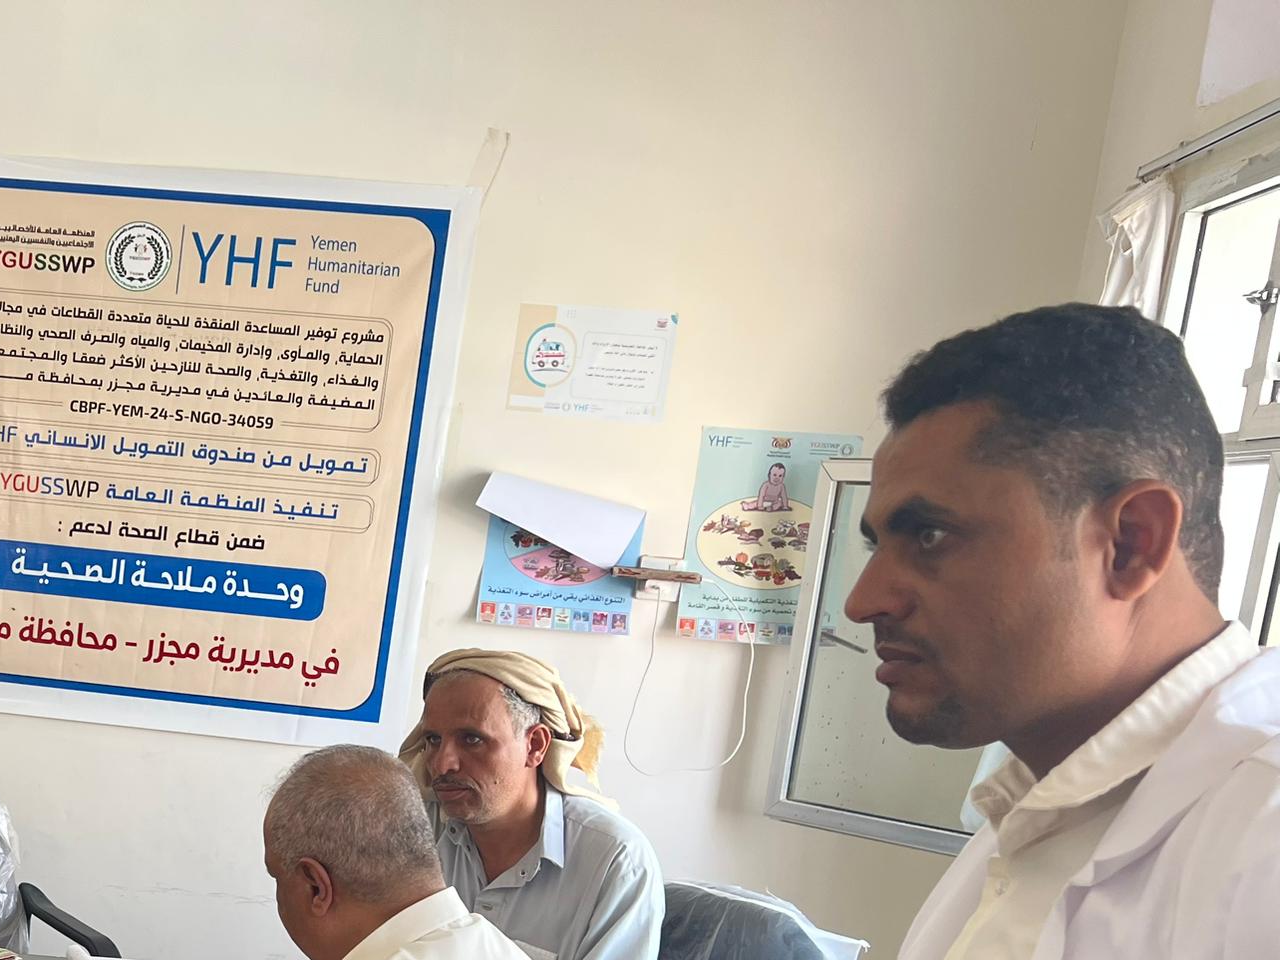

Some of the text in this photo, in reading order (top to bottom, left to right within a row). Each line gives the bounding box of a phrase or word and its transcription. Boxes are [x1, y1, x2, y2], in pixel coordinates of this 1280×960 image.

[310, 234, 357, 253] Yemen
[192, 231, 297, 289] YHF
[307, 256, 401, 278] Humanitarian
[305, 277, 340, 294] Fund
[27, 304, 47, 318] في
[51, 305, 103, 321] القطاعات
[107, 310, 152, 324] متعددة
[156, 313, 190, 329] للحياة
[194, 316, 240, 332] المنقذة
[244, 320, 301, 337] المساعدة
[38, 327, 76, 341] الصحي
[80, 331, 126, 347] والصرف
[303, 326, 338, 343] توفير
[340, 328, 385, 345] مشروع
[130, 335, 171, 352] والمياه
[236, 341, 272, 360] وإدارة
[109, 353, 146, 370] الأكثر
[150, 358, 201, 375] للنازحين
[37, 370, 104, 391] بمحافظة
[205, 362, 252, 381] والصحة
[106, 377, 146, 392] مجزر
[150, 380, 201, 397] مديرية
[205, 385, 230, 400] في
[233, 388, 303, 407] والعائدين
[307, 393, 376, 410] المضيفة
[69, 400, 275, 429] CBPF-YEM-24-S-NGO-34059
[24, 429, 106, 450] الانساني
[112, 436, 185, 459] التمويل
[708, 434, 734, 448] YHF
[192, 443, 256, 465] صندوق
[262, 450, 292, 468] من
[298, 453, 369, 476] تمويل
[0, 472, 339, 520] تنفيذ المنظمة العامة YGUSSWP
[69, 520, 113, 538] لدعم
[118, 521, 168, 541] الصحة
[174, 528, 220, 548] قطاع
[226, 532, 265, 551] ضمن
[11, 547, 305, 610] وحدة ملاحة الصحية
[18, 615, 118, 652] محافظة
[142, 632, 201, 667] مجزر
[207, 635, 294, 675] مديرية
[300, 648, 340, 688] في
